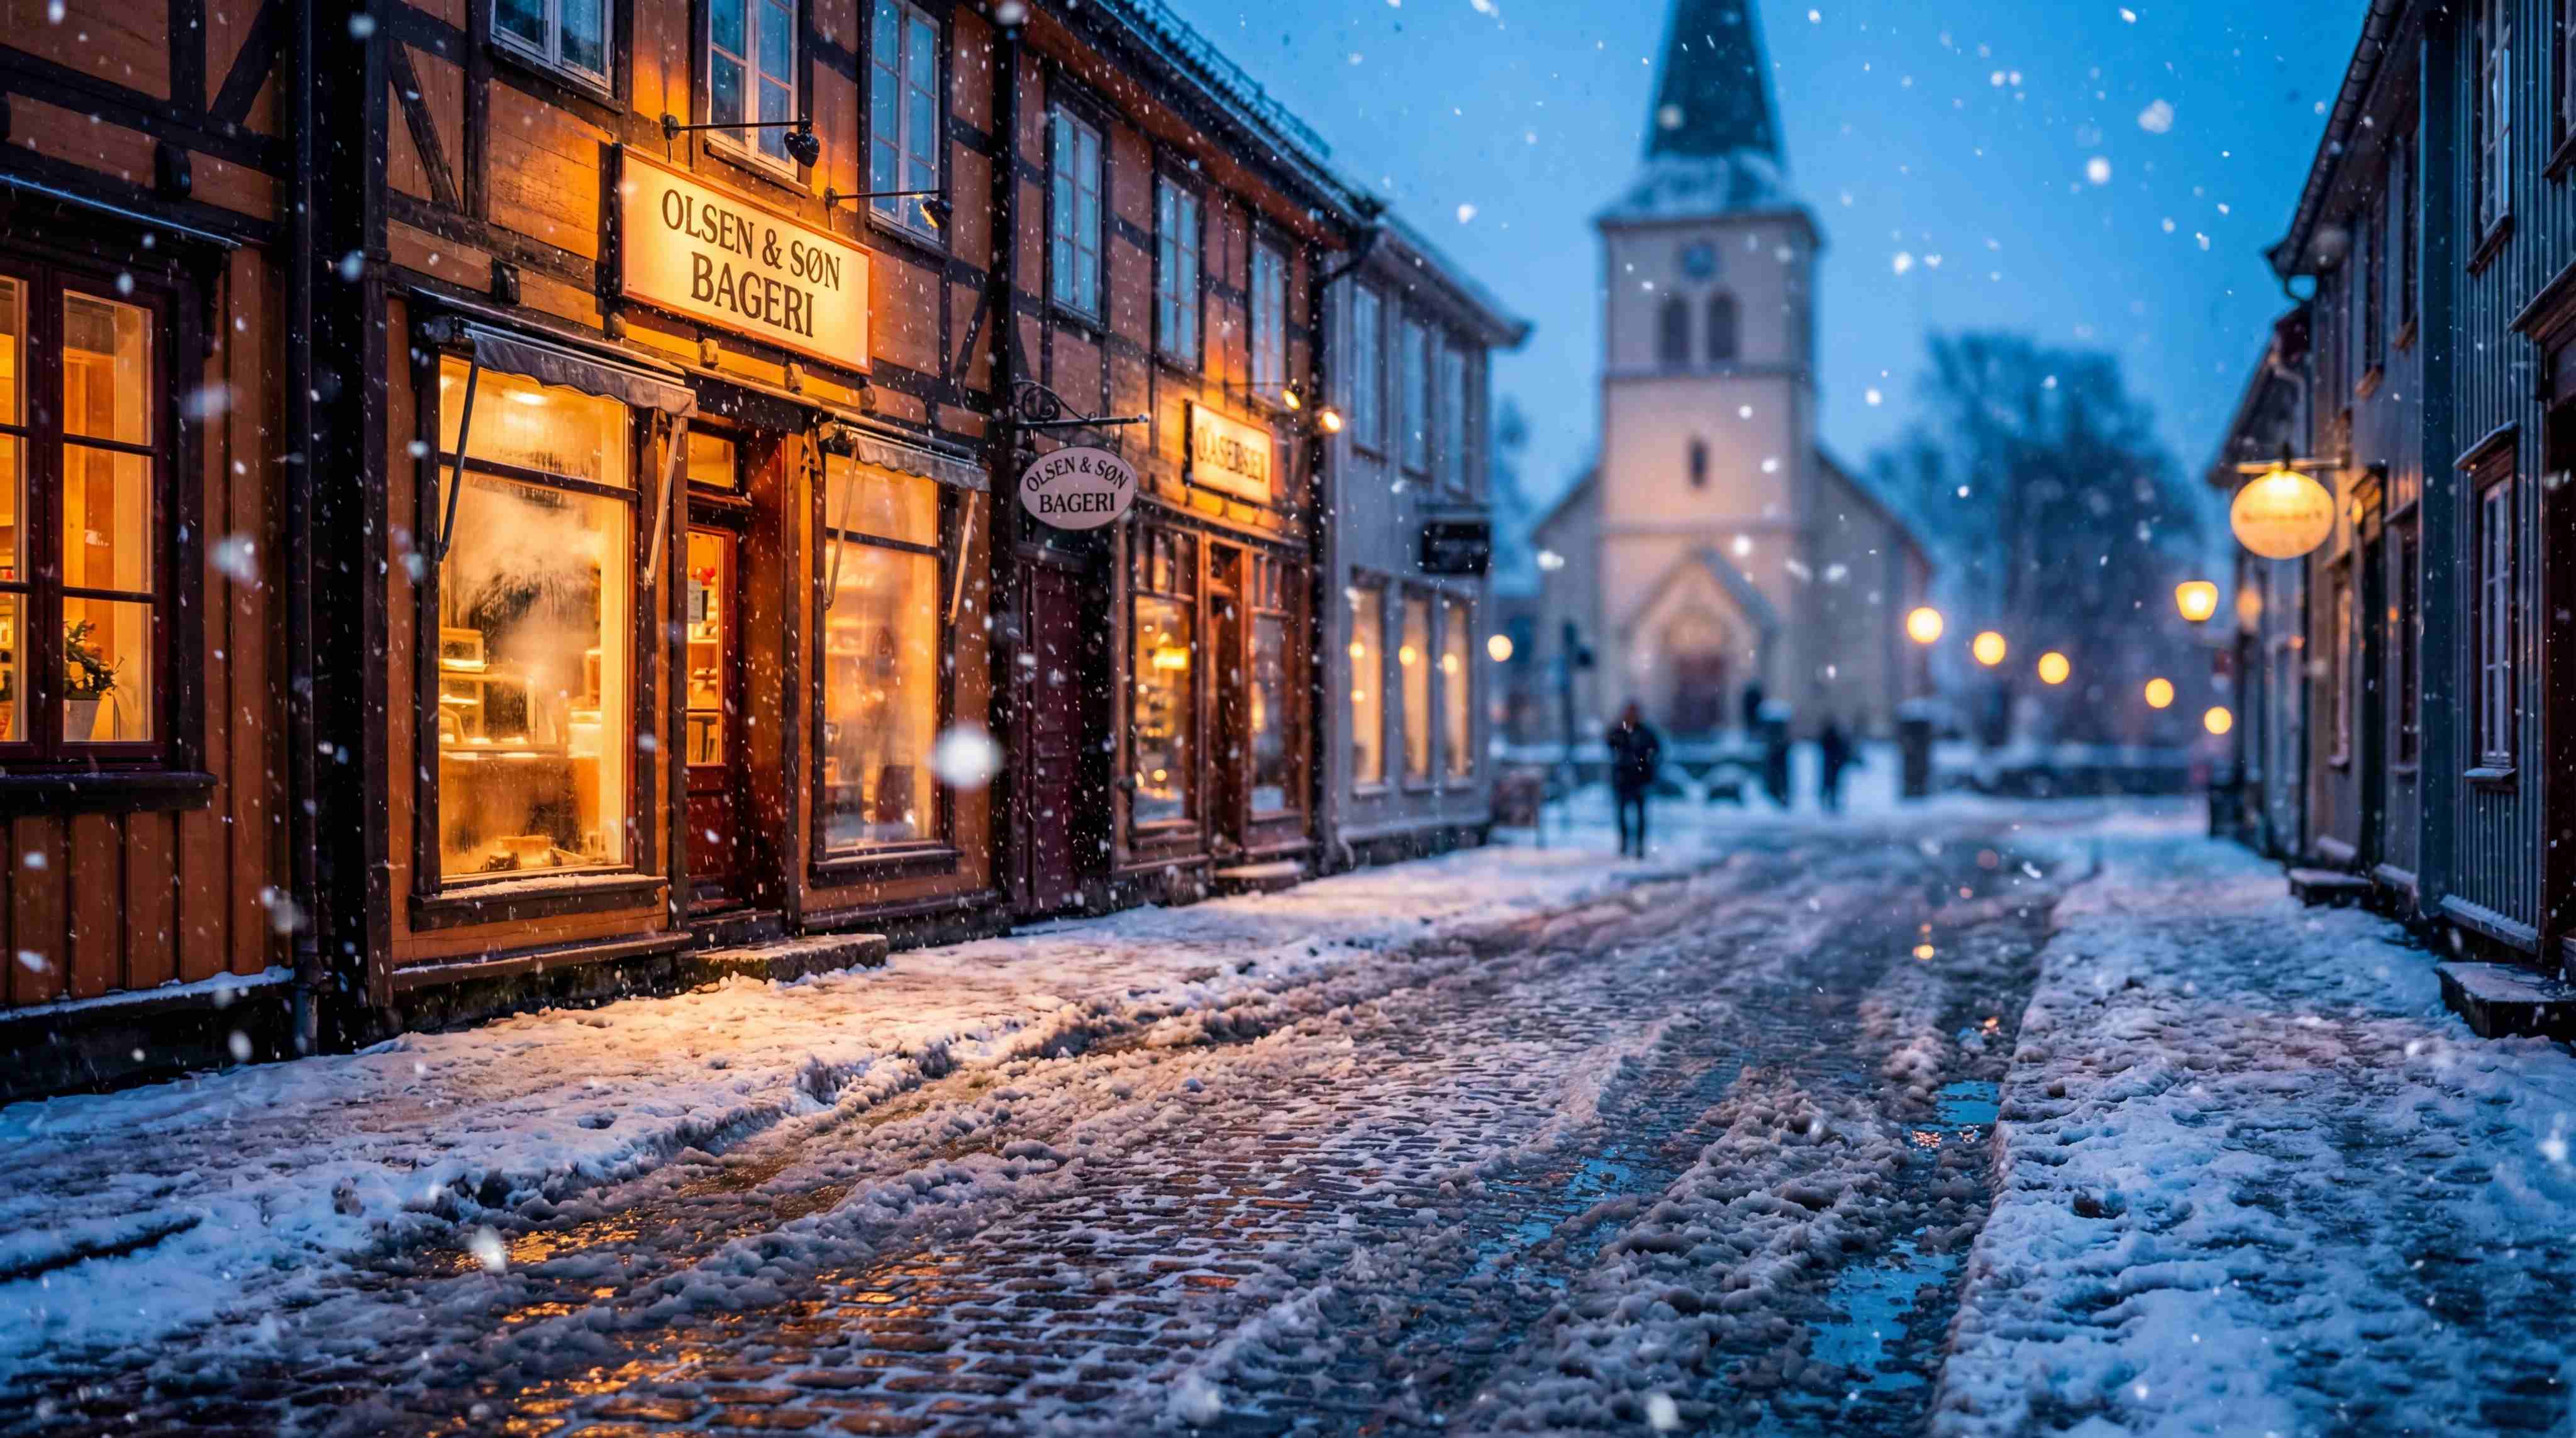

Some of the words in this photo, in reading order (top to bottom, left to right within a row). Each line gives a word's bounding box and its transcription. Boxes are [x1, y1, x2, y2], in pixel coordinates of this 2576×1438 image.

[662, 189, 754, 259] OLSEN
[762, 228, 783, 269] &
[791, 240, 840, 291] SØN
[691, 252, 814, 337] BAGERI
[1026, 457, 1075, 492] OLSEN
[1080, 457, 1092, 474] &
[1095, 460, 1129, 489] SØN
[1040, 493, 1115, 513] BAGERI
